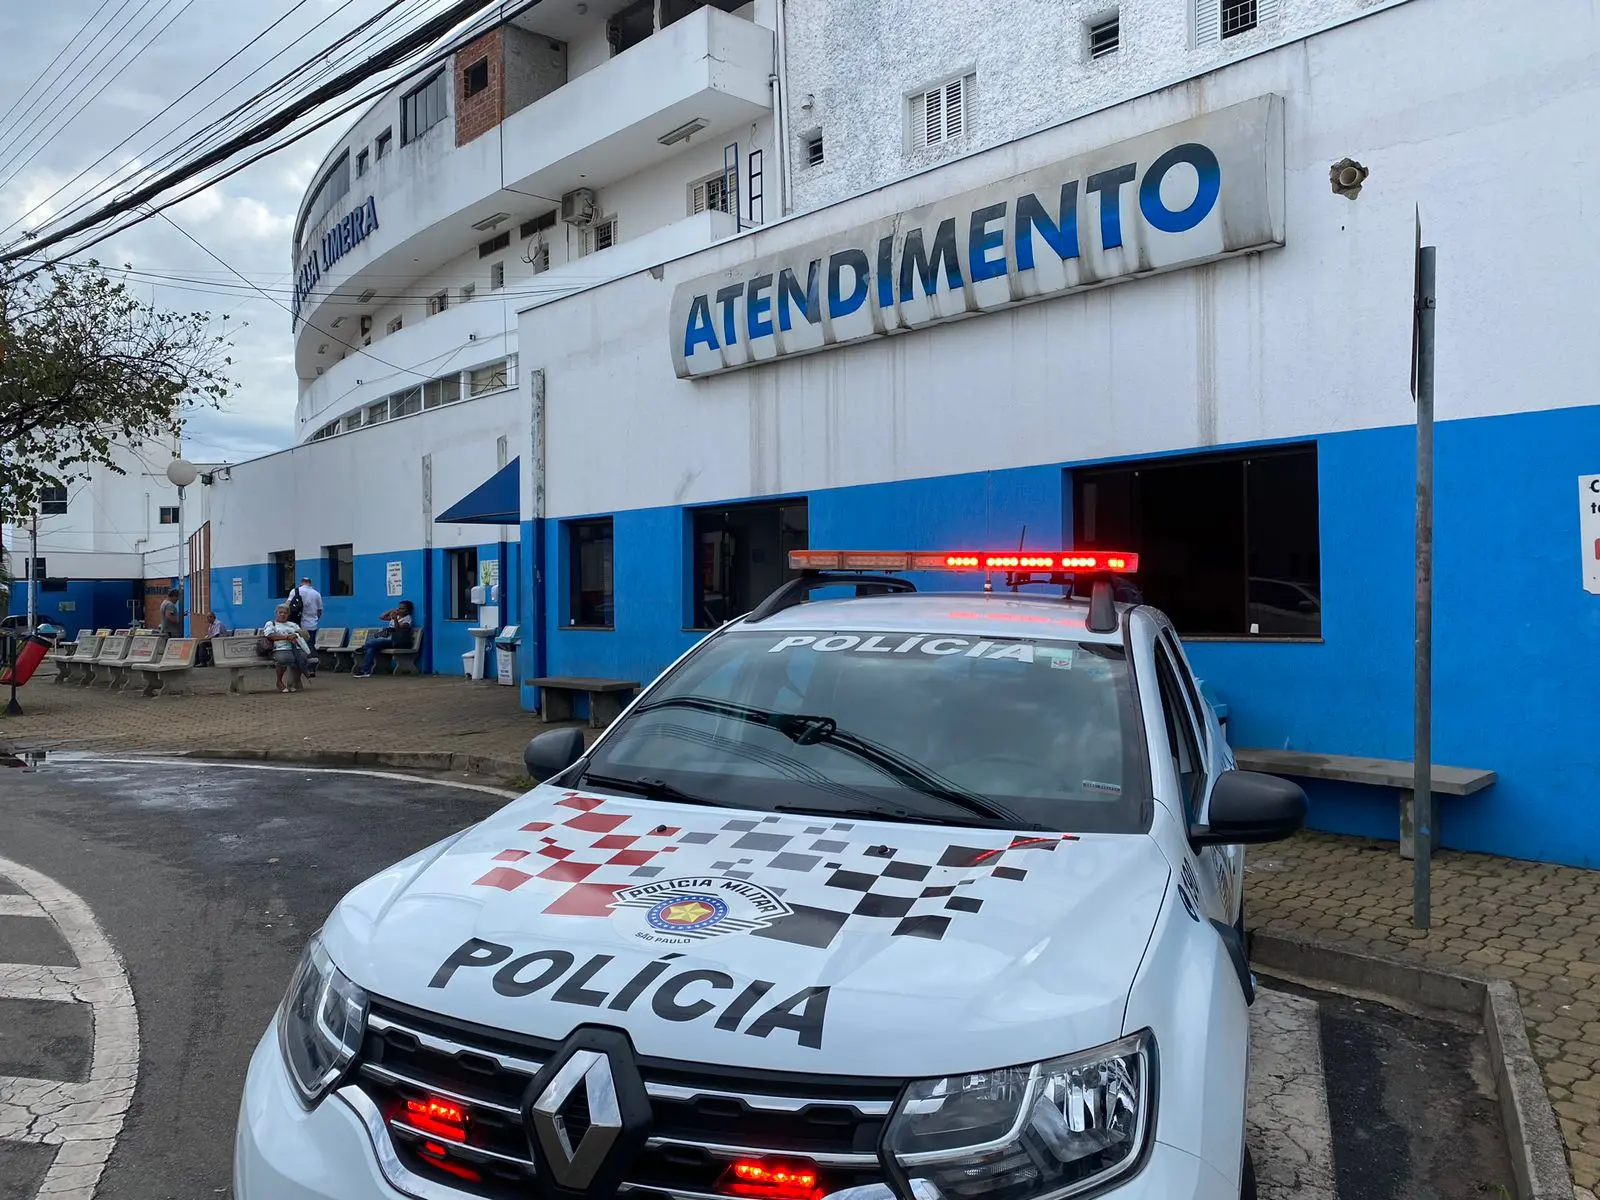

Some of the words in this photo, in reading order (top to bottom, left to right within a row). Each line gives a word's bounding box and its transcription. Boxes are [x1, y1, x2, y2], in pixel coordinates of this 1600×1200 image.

[321, 195, 379, 272] LIMEIRA
[683, 142, 1221, 358] ATENDIMENTO
[768, 634, 1034, 663] POLÍCIA
[629, 879, 713, 899] POLÍCIA
[720, 881, 778, 913] MILITAR
[634, 931, 652, 941] SÃO
[427, 937, 832, 1050] POLÍCIA
